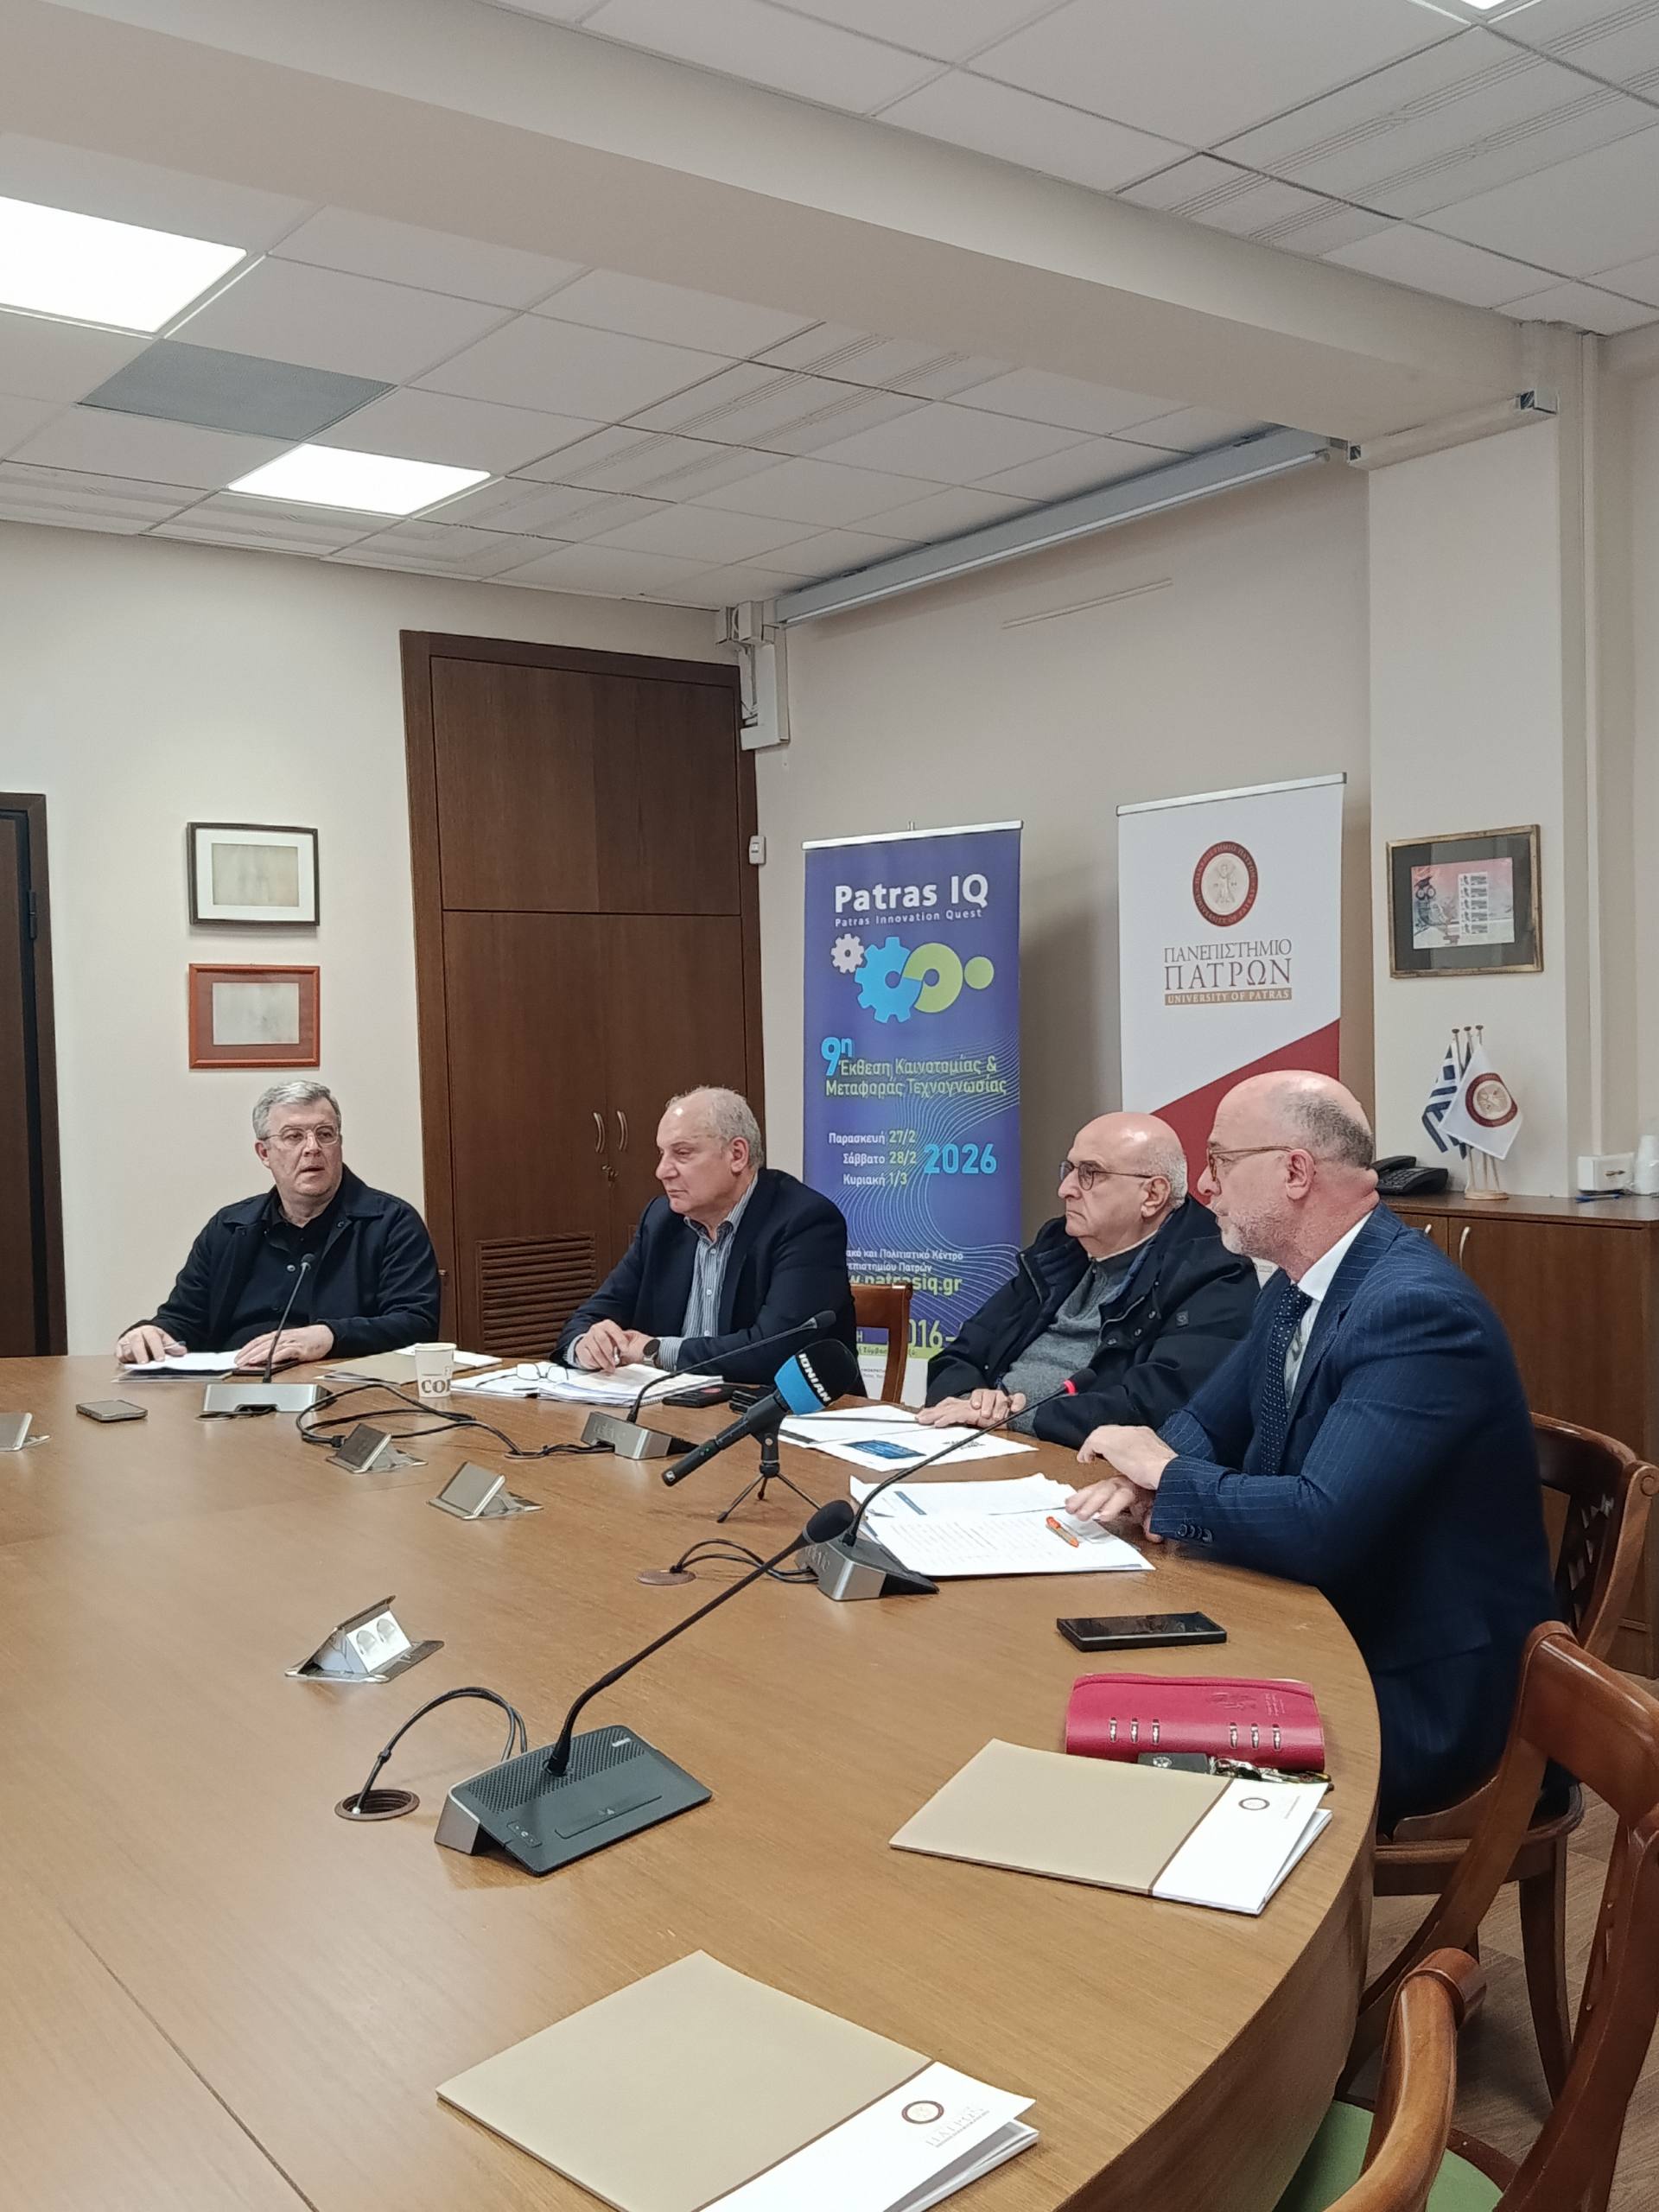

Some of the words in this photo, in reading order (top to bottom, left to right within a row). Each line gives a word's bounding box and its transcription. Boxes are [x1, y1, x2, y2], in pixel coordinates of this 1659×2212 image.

[835, 883, 938, 912] Patras
[950, 874, 988, 907] IQ
[835, 916, 870, 927] Patras
[875, 912, 940, 925] Innovation
[945, 909, 982, 920] Quest
[1164, 938, 1292, 963] ΠΑΝΕΠΙΣΤΗΜΙΟ
[1164, 958, 1292, 990] ΠΑΤΡΩΝ
[1167, 993, 1230, 1004] UNIVERSITY
[1230, 992, 1245, 1001] OF
[1249, 989, 1290, 1000] PATRAS
[895, 1053, 982, 1076] Καινοτομίας
[986, 1055, 997, 1072] &
[826, 1077, 904, 1099] Μεταφοράς
[907, 1075, 1007, 1098] Τεχνογνωσίας
[829, 1131, 886, 1146] Παρασκευή
[888, 1128, 917, 1146] 27/2
[842, 1152, 886, 1166] Σάββατο
[888, 1150, 918, 1166] 28/2
[923, 1143, 998, 1174] 2026
[842, 1173, 886, 1187] Κυριακή
[889, 1170, 908, 1186] 1/3
[864, 1249, 878, 1258] και
[932, 1249, 964, 1262] Κέντρο
[899, 1262, 932, 1274] Πατρών
[798, 1352, 832, 1402] IONIAN
